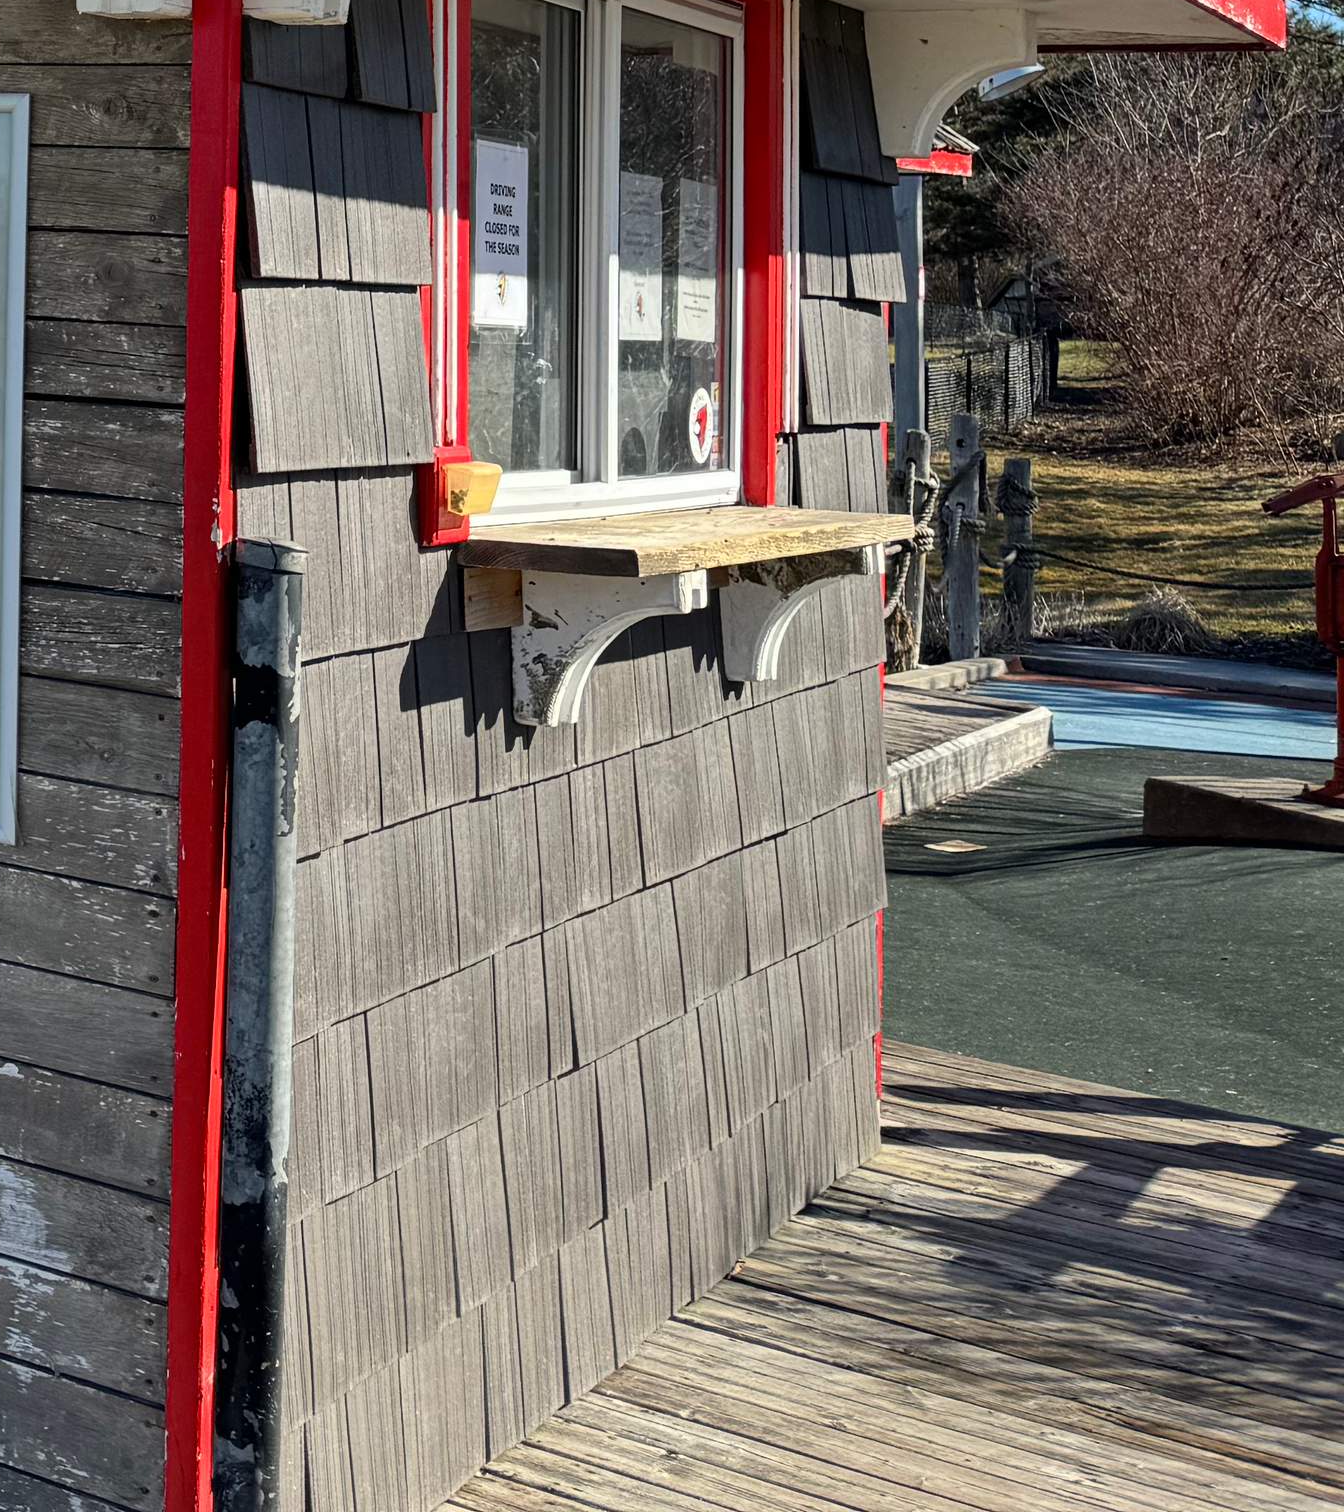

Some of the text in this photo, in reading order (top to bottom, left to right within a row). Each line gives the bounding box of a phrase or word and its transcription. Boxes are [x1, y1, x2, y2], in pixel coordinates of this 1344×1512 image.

[490, 183, 516, 198] DRIVING
[493, 203, 513, 217] RANGE
[484, 221, 520, 237] CLOSED FOR
[484, 240, 520, 256] THE SEASON
